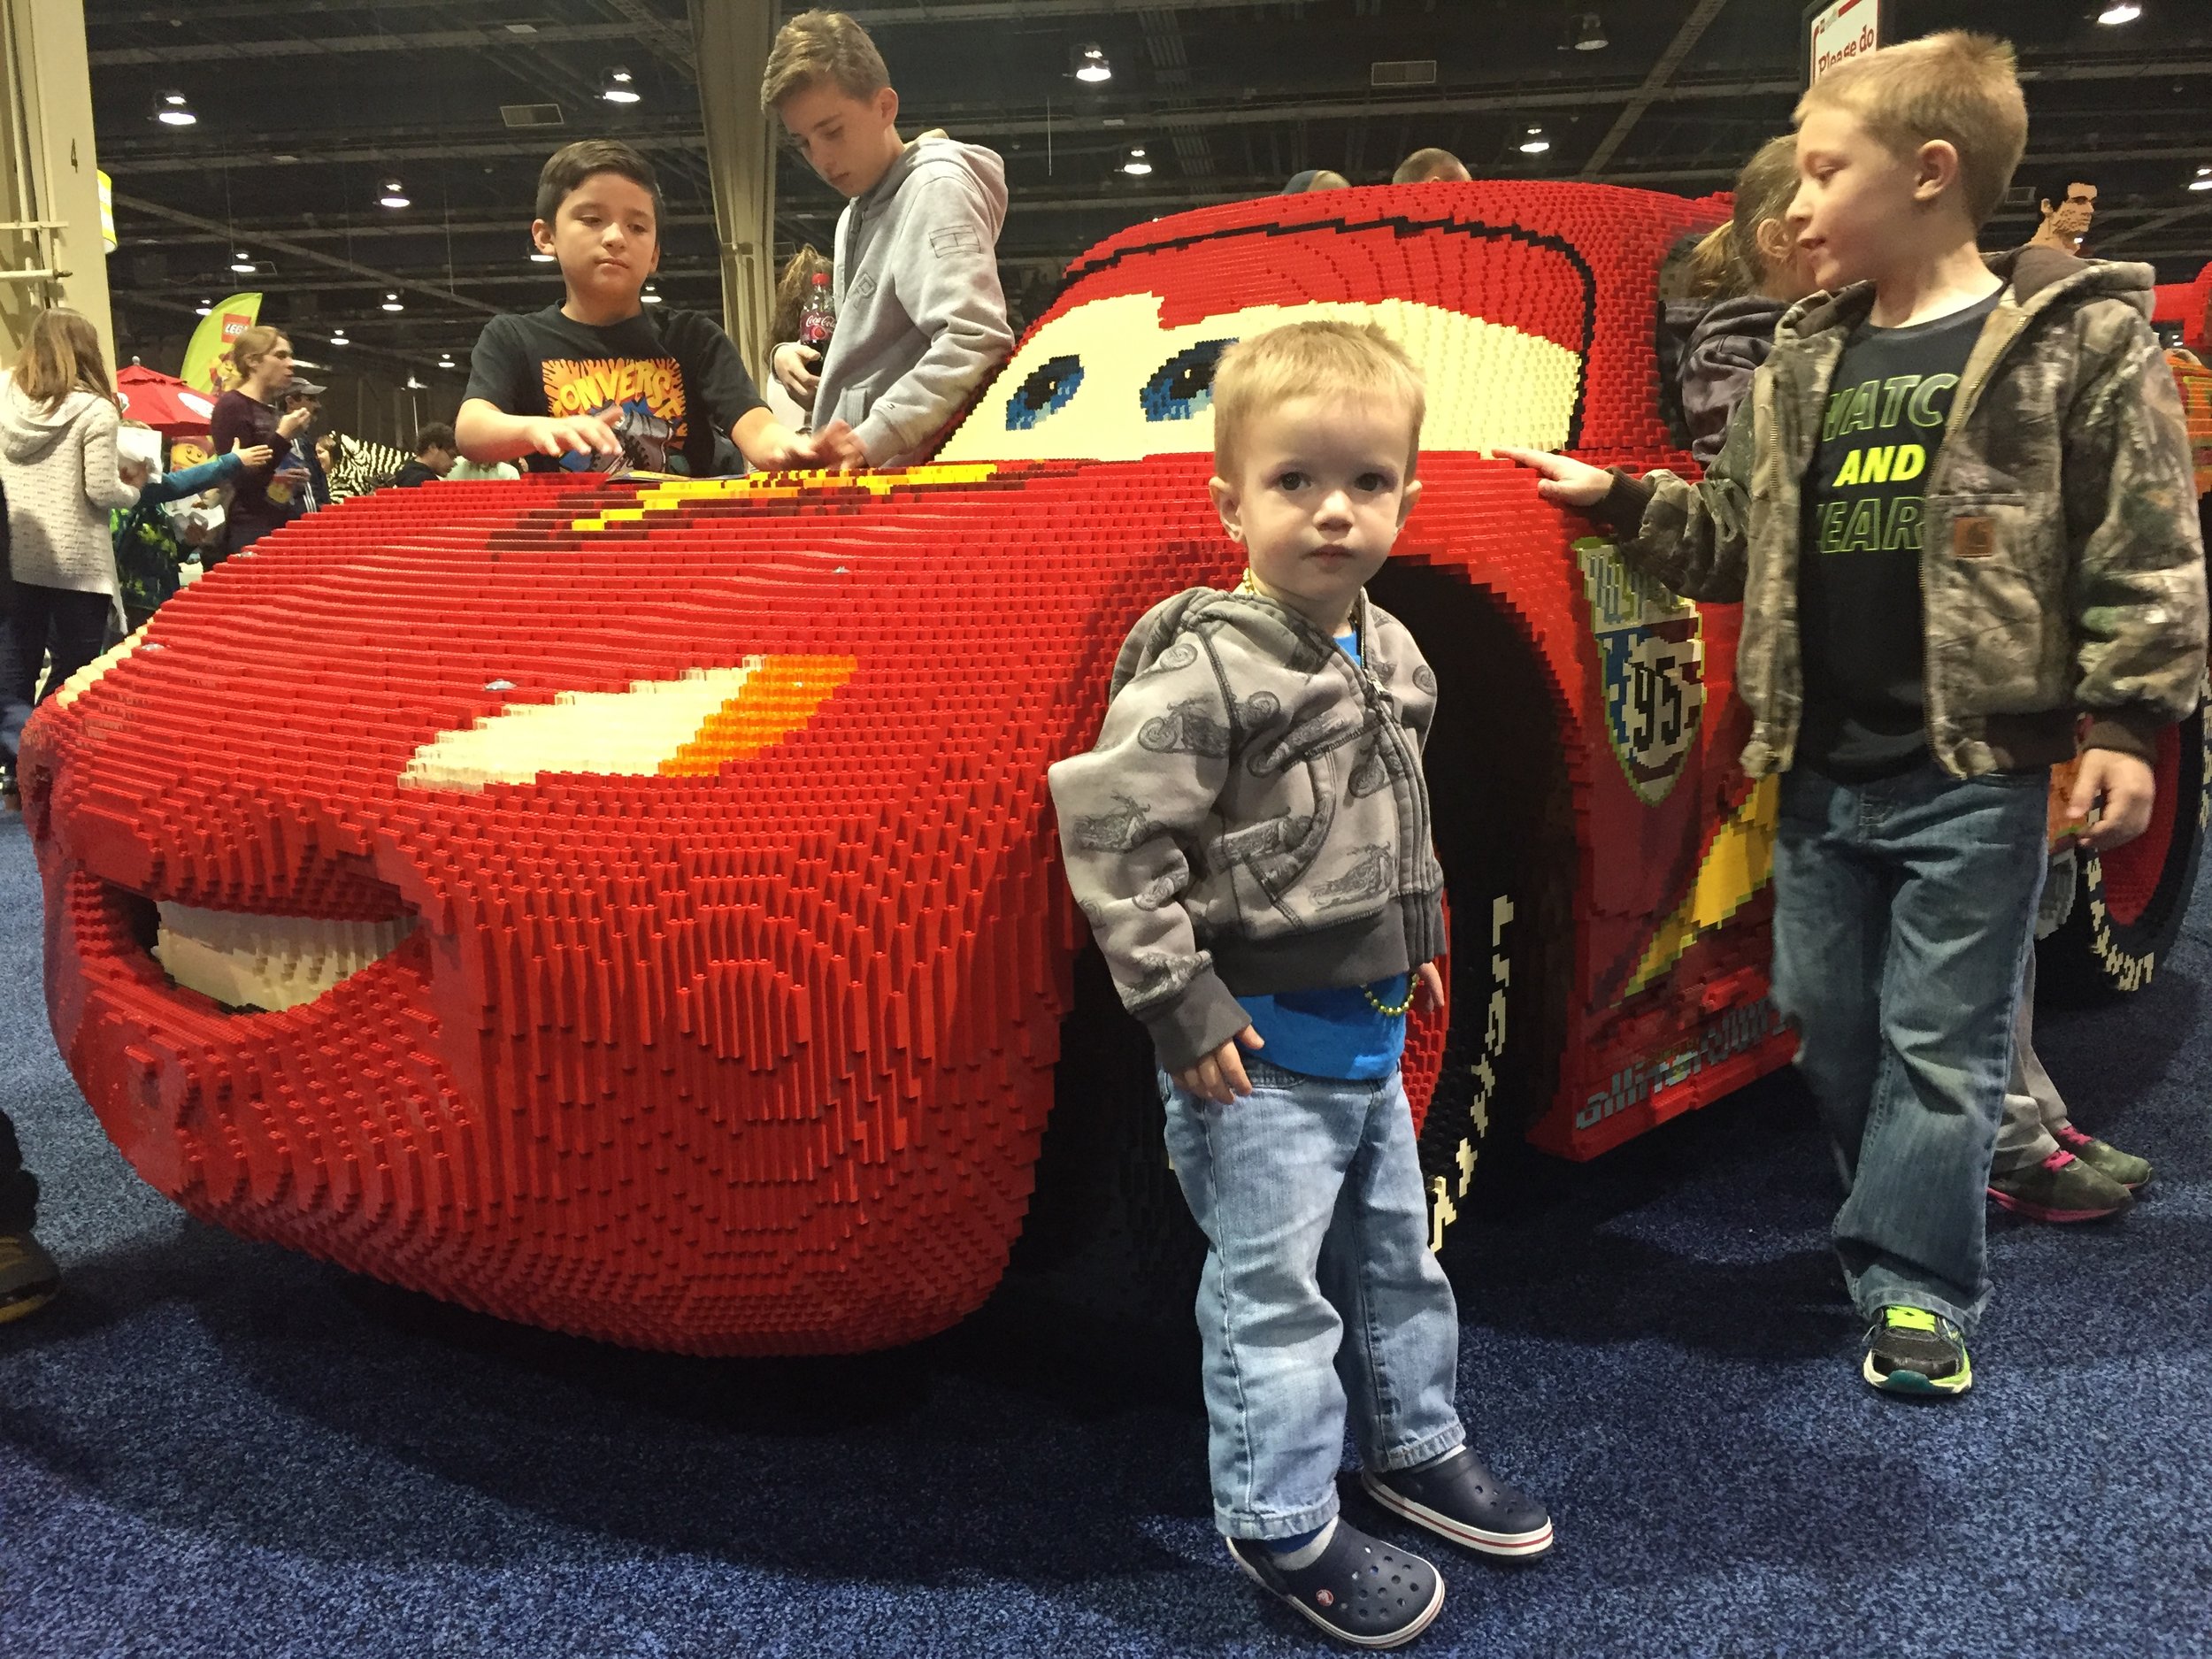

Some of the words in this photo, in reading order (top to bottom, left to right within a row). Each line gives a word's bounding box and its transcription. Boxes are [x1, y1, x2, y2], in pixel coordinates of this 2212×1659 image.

[1818, 41, 1857, 73] Please
[1859, 25, 1874, 52] do
[226, 323, 248, 334] LEG
[1832, 443, 1926, 488] AND
[1816, 495, 1925, 554] EAR
[1632, 656, 1682, 752] 95
